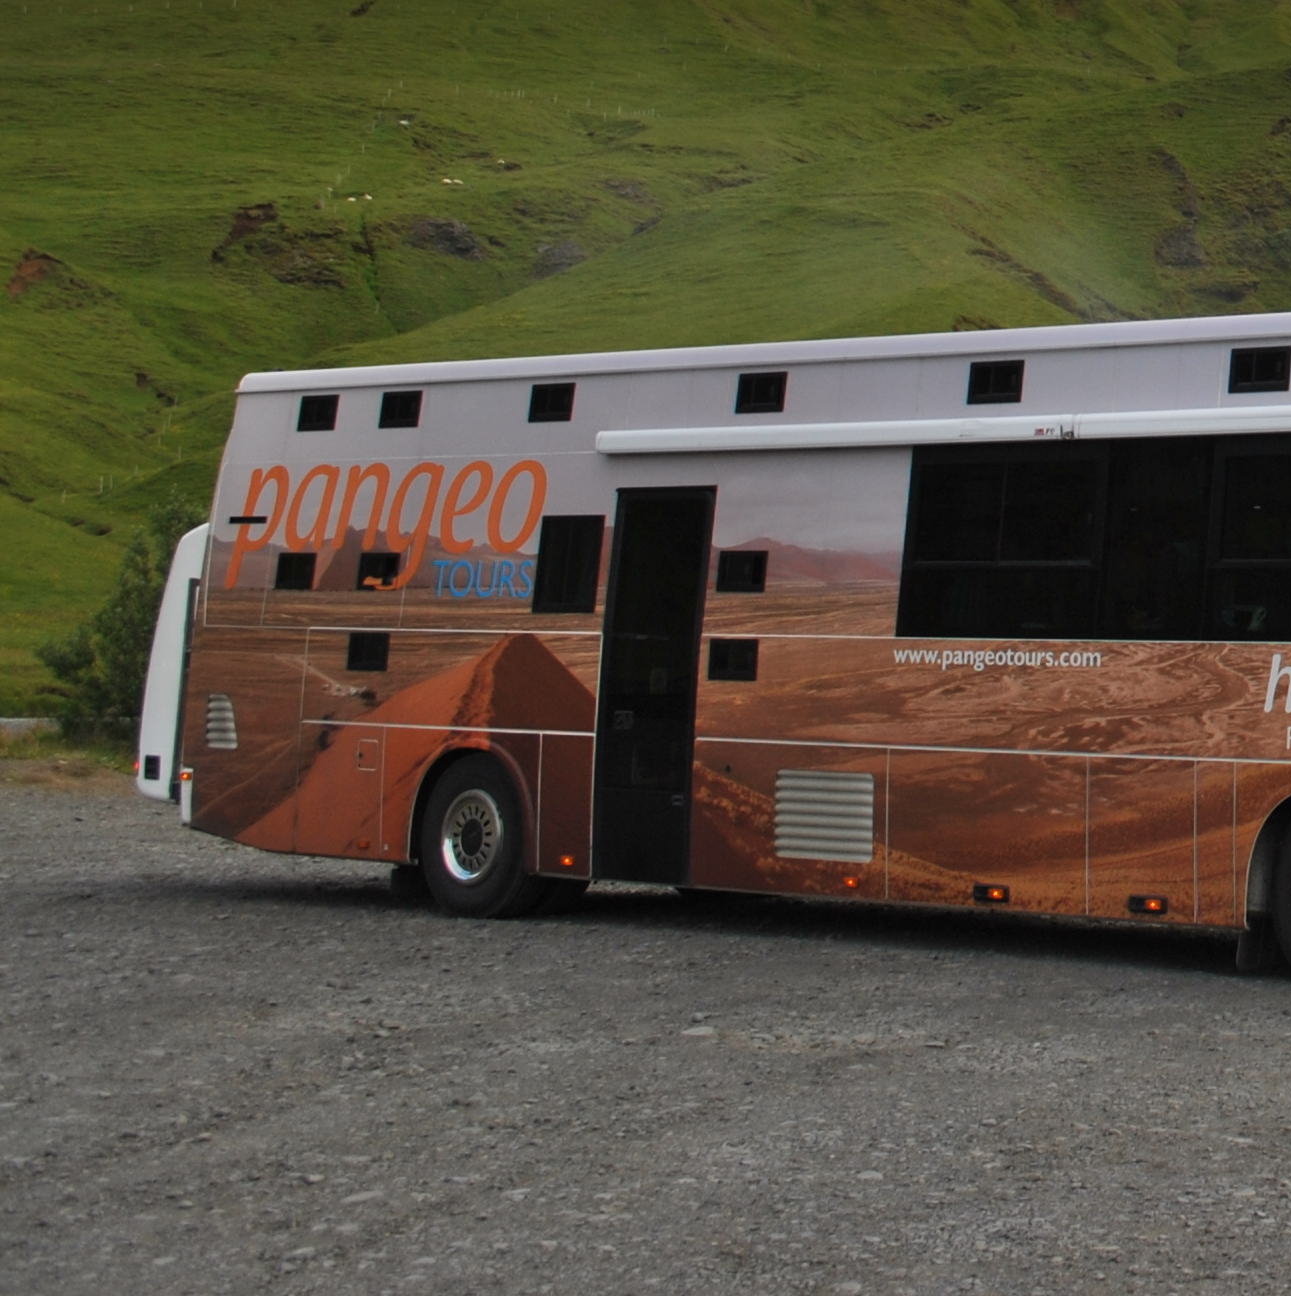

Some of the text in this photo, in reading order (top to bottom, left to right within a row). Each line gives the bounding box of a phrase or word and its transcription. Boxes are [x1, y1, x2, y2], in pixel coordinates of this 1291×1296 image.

[224, 460, 548, 590] pangeo
[432, 559, 534, 599] TOURS
[894, 648, 1101, 671] www.pangeotours.com
